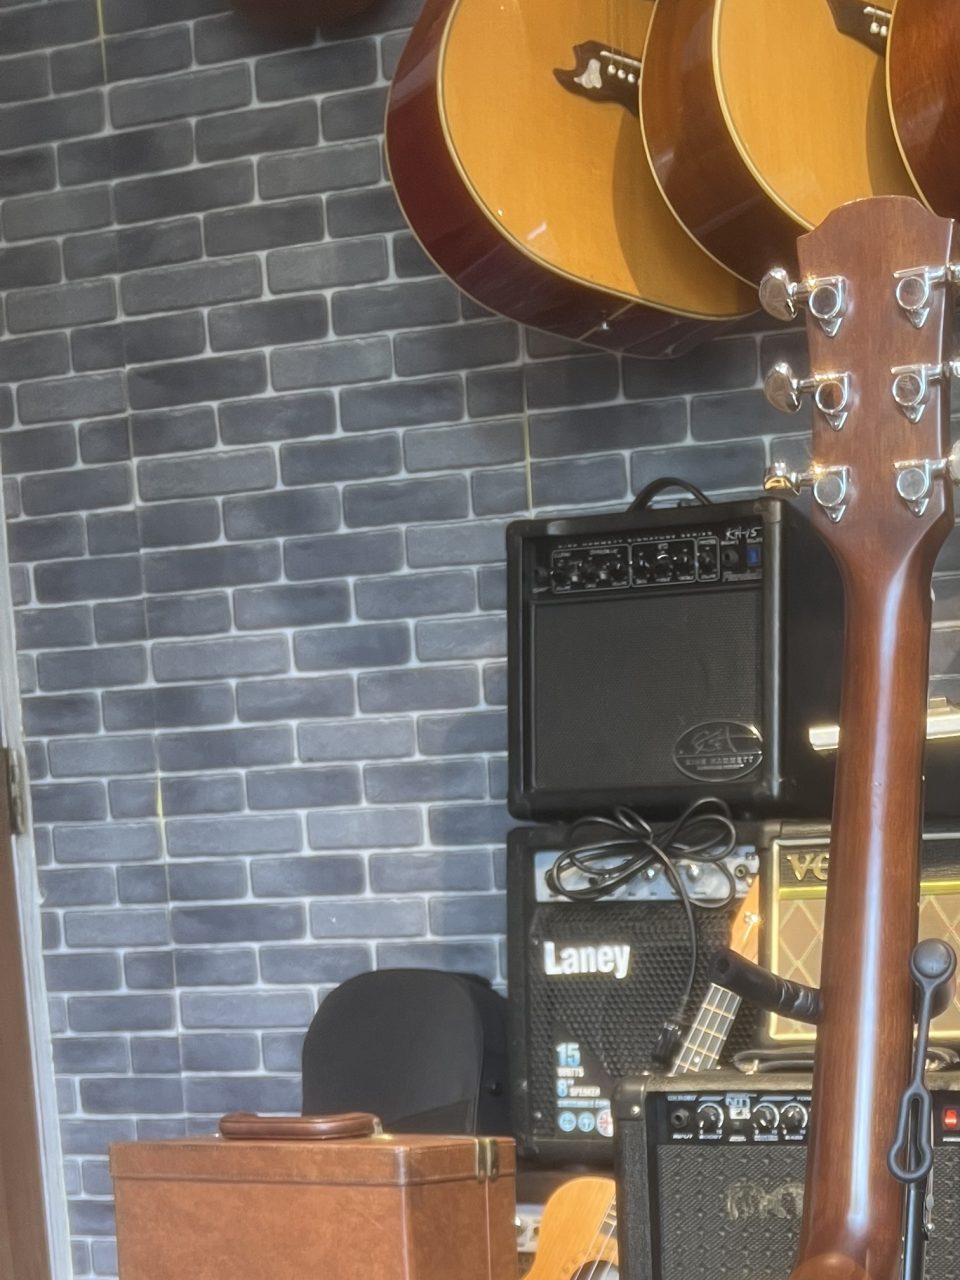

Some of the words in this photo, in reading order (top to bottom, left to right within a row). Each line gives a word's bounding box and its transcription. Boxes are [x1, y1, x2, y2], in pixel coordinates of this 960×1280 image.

[786, 852, 830, 881] VO
[543, 940, 631, 980] Laney
[556, 1042, 581, 1067] 15
